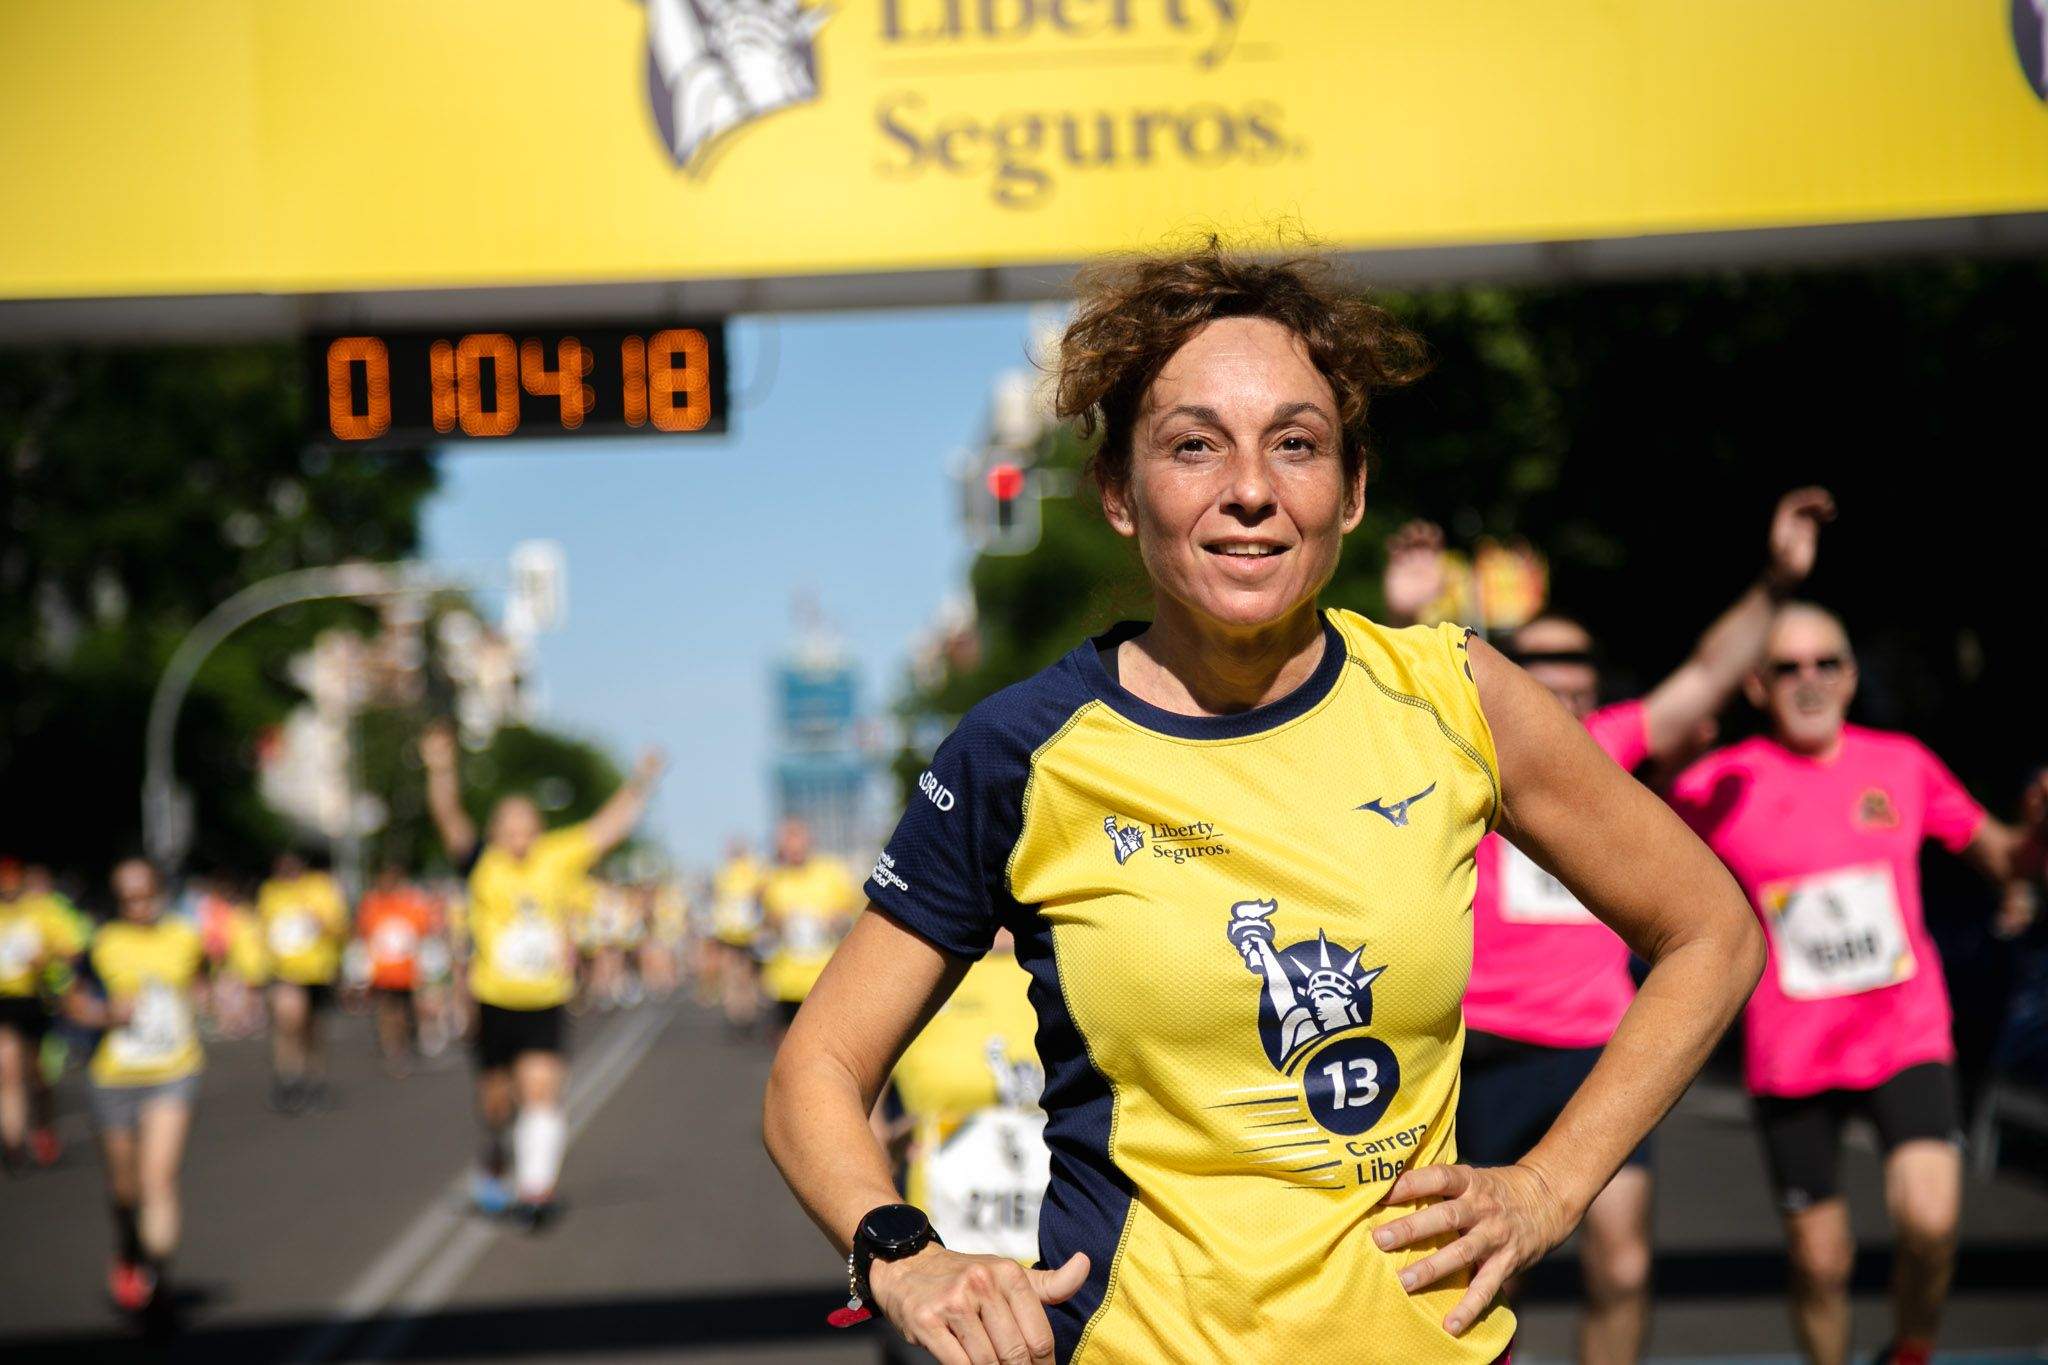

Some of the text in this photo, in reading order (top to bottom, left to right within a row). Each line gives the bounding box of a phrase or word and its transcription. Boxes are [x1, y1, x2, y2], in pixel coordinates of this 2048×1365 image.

[327, 336, 391, 440] 0
[1150, 821, 1214, 841] Liberty
[1323, 1057, 1380, 1110] 13
